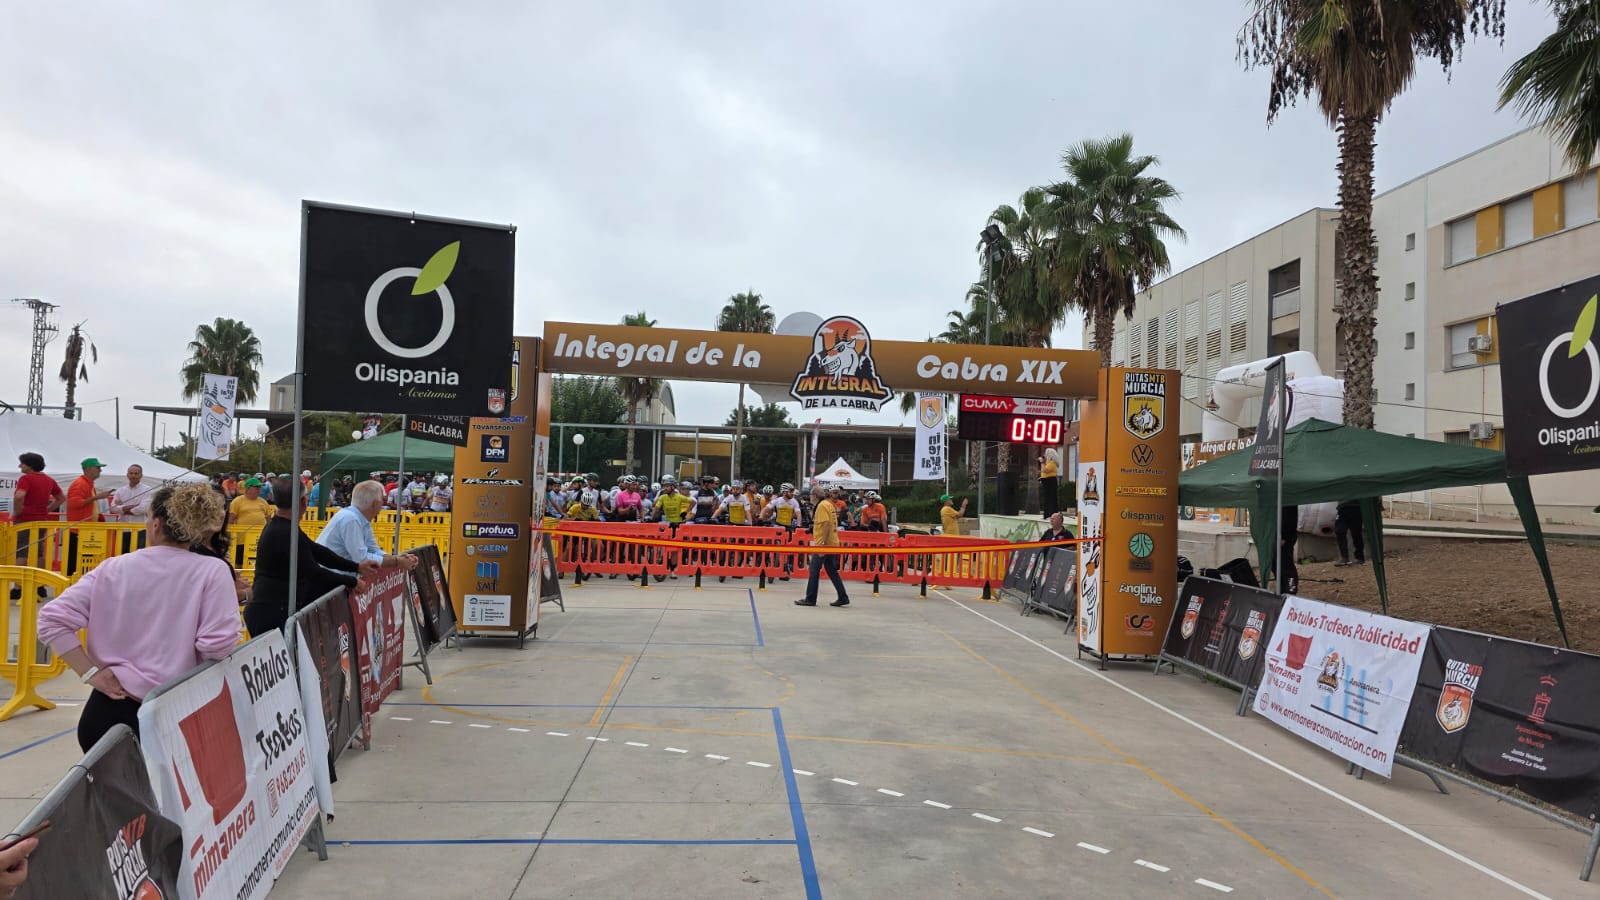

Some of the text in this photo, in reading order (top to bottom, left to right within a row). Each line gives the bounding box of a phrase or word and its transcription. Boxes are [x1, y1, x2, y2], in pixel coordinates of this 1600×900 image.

[553, 332, 762, 369] Integral de la
[355, 362, 460, 387] Olispania
[916, 354, 1068, 385] Cabra XIX
[796, 375, 887, 395] INTEGRAL
[1124, 382, 1165, 395] MURCIA
[805, 398, 877, 412] DE LA CABRA
[964, 398, 1009, 410] CUMA
[1011, 418, 1061, 443] 0:00
[1538, 421, 1600, 446] Olispani
[486, 448, 505, 457] DFM
[478, 525, 515, 537] profusa
[1140, 593, 1163, 605] bike
[1353, 623, 1422, 655] Publicidad
[240, 645, 290, 705] Rótulos
[1445, 668, 1480, 690] MURCIA
[255, 708, 302, 770] Trofeos
[193, 800, 256, 899] mimanera
